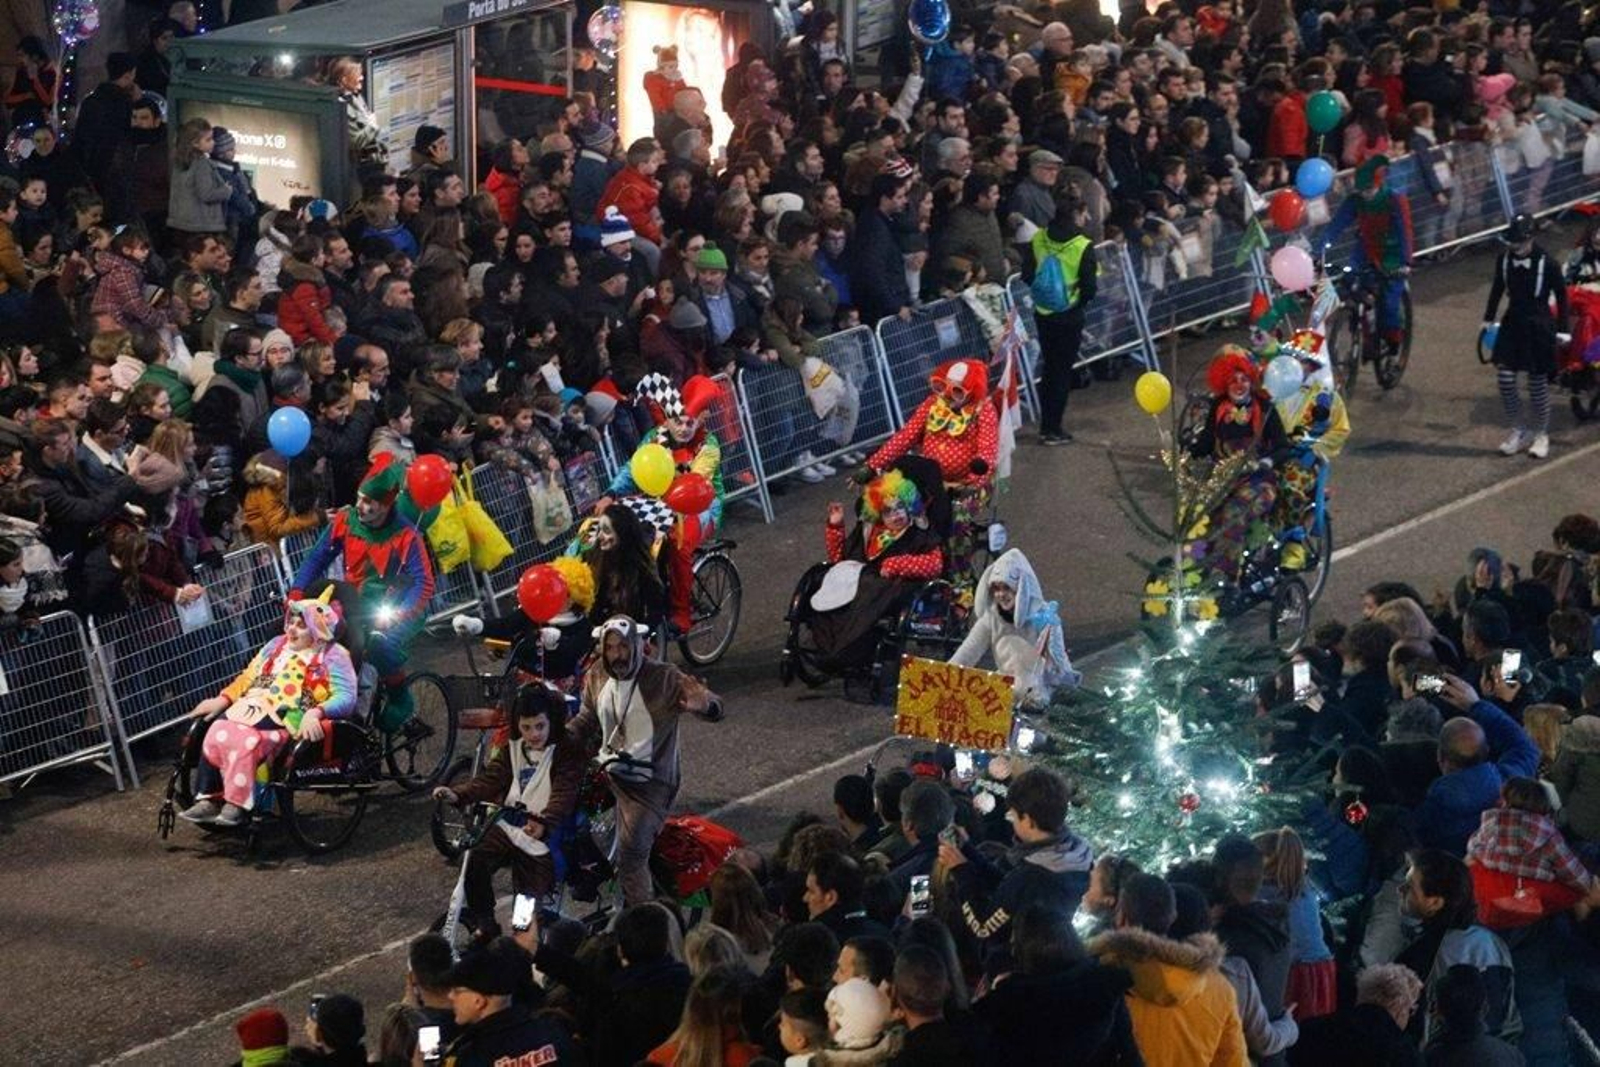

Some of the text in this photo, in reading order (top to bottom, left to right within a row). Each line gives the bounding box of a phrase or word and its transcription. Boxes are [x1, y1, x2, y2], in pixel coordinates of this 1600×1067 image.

[468, 0, 495, 19] Porta
[264, 133, 274, 147] X
[899, 713, 1006, 750] EL MAGO
